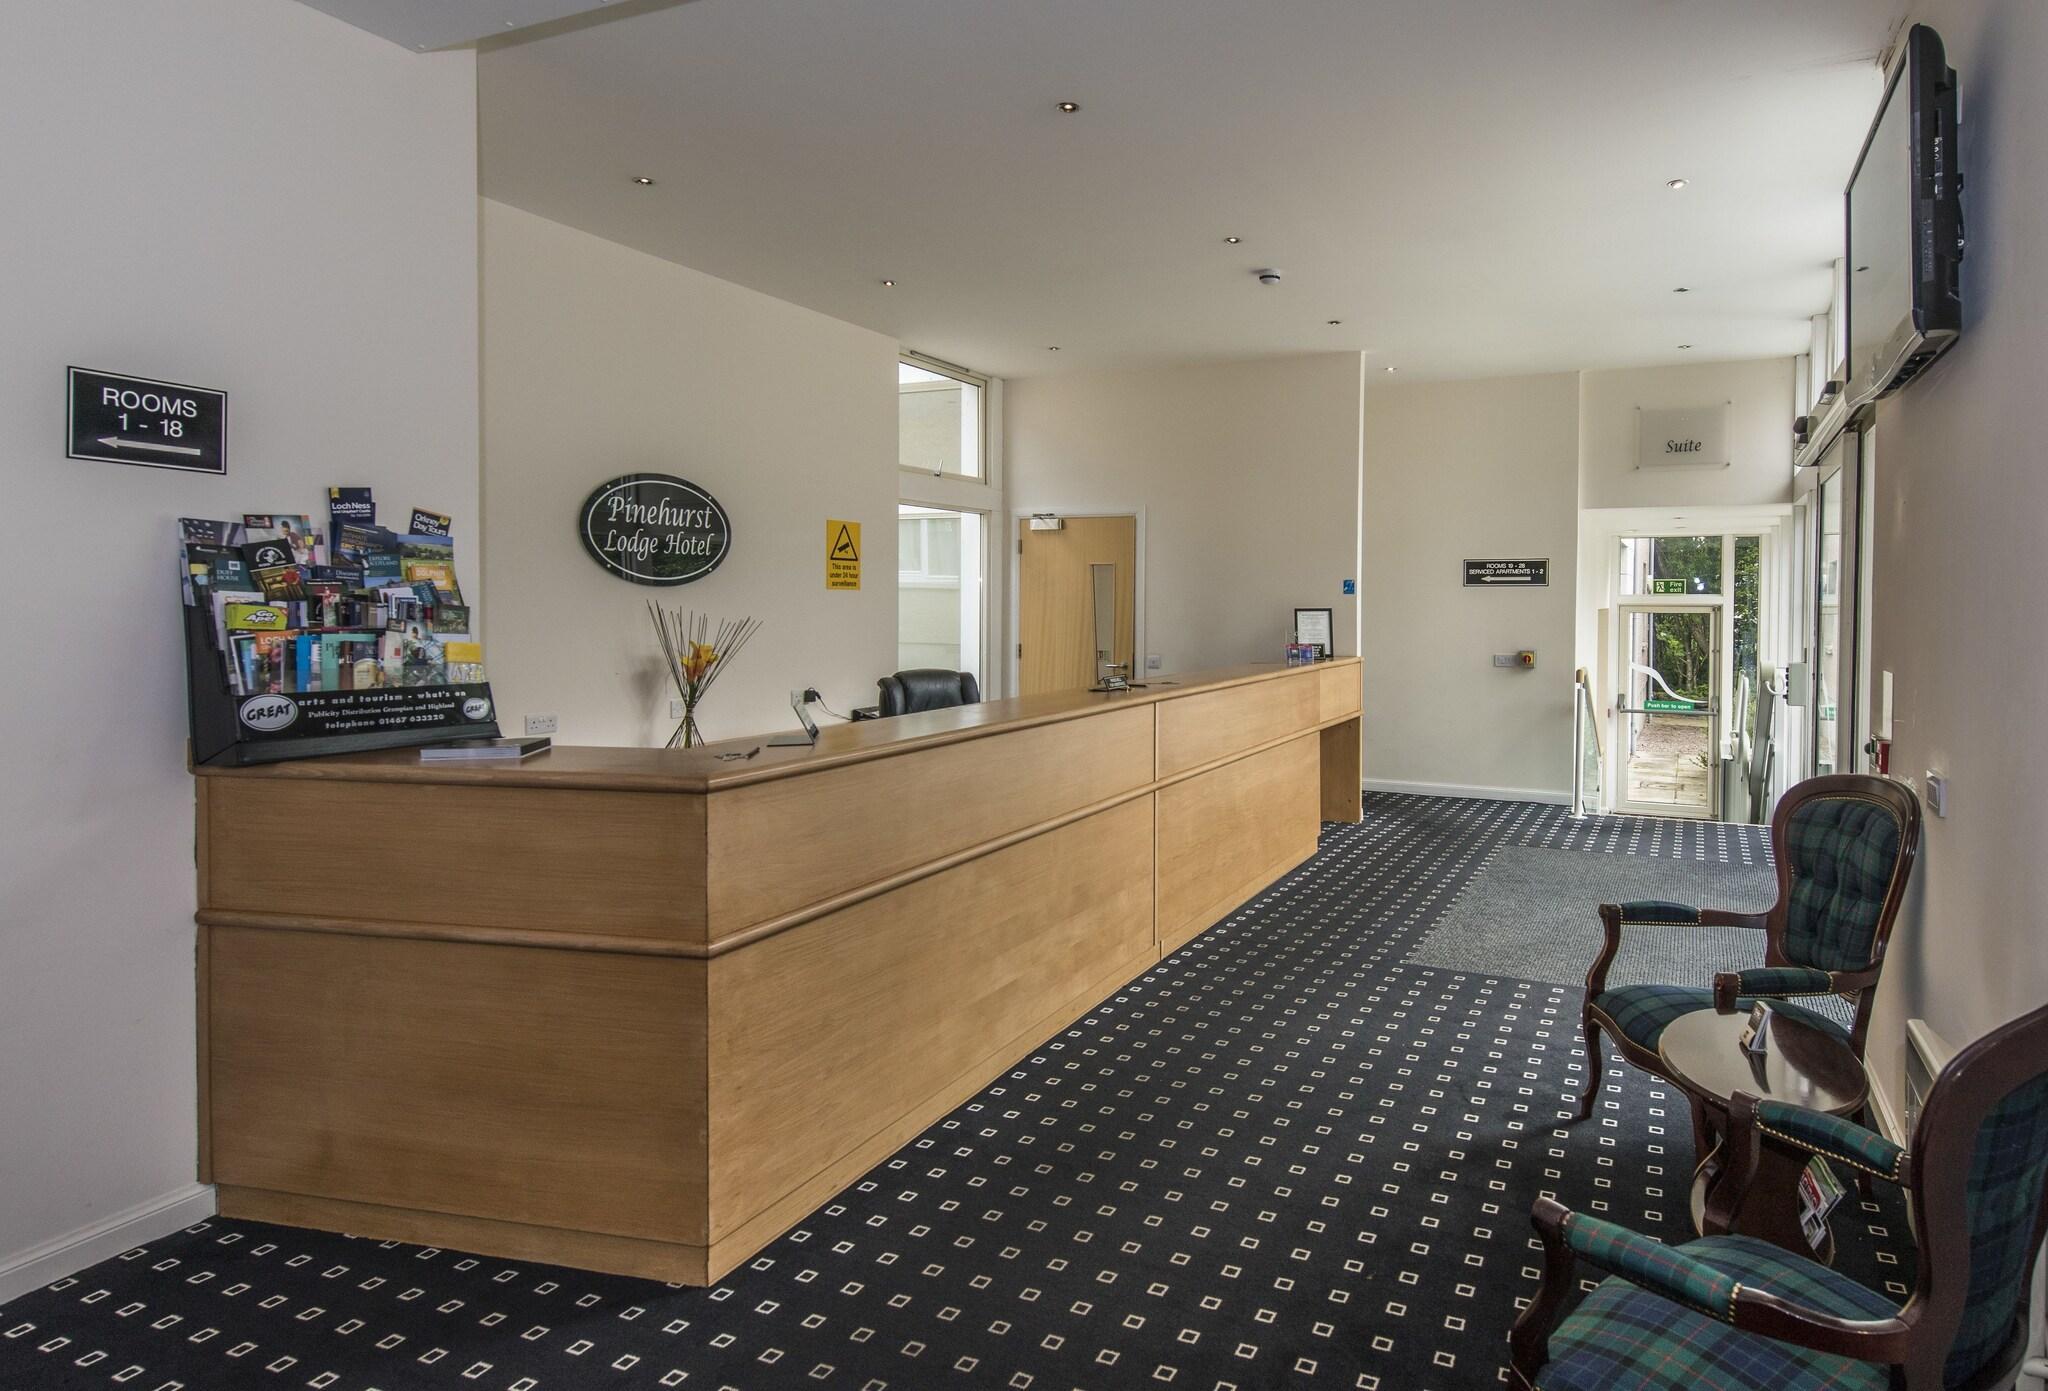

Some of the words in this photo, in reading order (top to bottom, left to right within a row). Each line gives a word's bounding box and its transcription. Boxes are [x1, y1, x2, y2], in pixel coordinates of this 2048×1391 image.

[103, 387, 197, 418] ROOMS
[118, 413, 128, 431] 1
[160, 419, 183, 438] 18
[1665, 439, 1702, 453] Suite
[331, 502, 351, 510] Loch
[607, 496, 713, 529] Pinehurst
[412, 520, 428, 533] Day
[428, 526, 447, 536] Tours
[414, 513, 440, 527] Orkney
[604, 528, 659, 561] Lodge
[663, 531, 715, 556] Hotel
[247, 614, 277, 623] Ape!
[298, 698, 325, 706] arts
[331, 696, 354, 704] and
[360, 693, 403, 702] tourism
[417, 690, 450, 699] what's
[247, 703, 291, 721] GREAT
[308, 710, 340, 719] Publicity
[383, 705, 414, 714] Grampian
[428, 702, 455, 710] Highland
[325, 720, 375, 729] telephone
